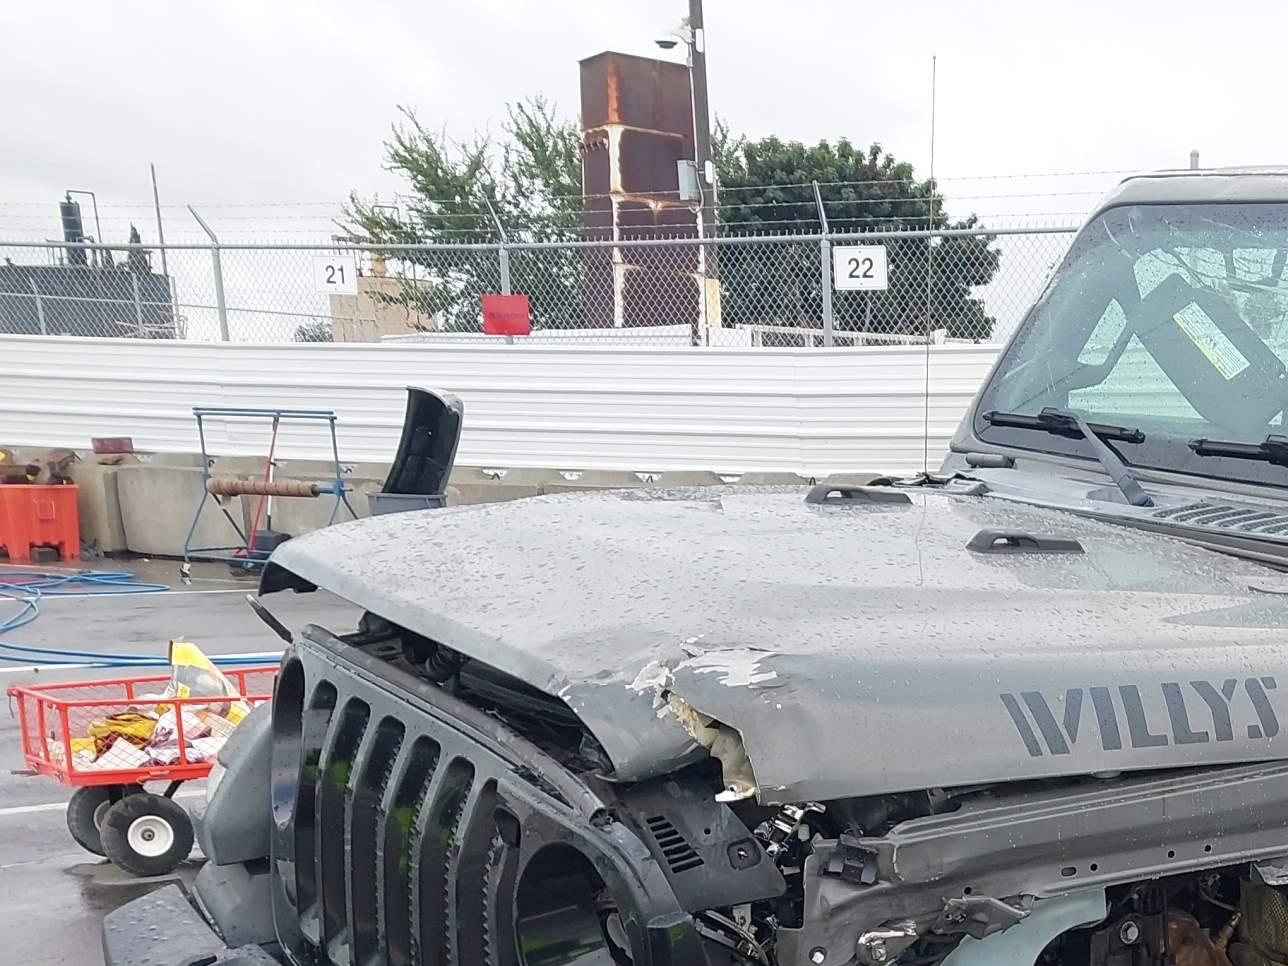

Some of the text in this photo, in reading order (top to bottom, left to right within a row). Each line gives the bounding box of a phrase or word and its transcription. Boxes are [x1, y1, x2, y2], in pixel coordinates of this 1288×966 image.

[325, 264, 345, 284] 21
[848, 257, 874, 278] 22
[1000, 676, 1280, 757] WILLYS
